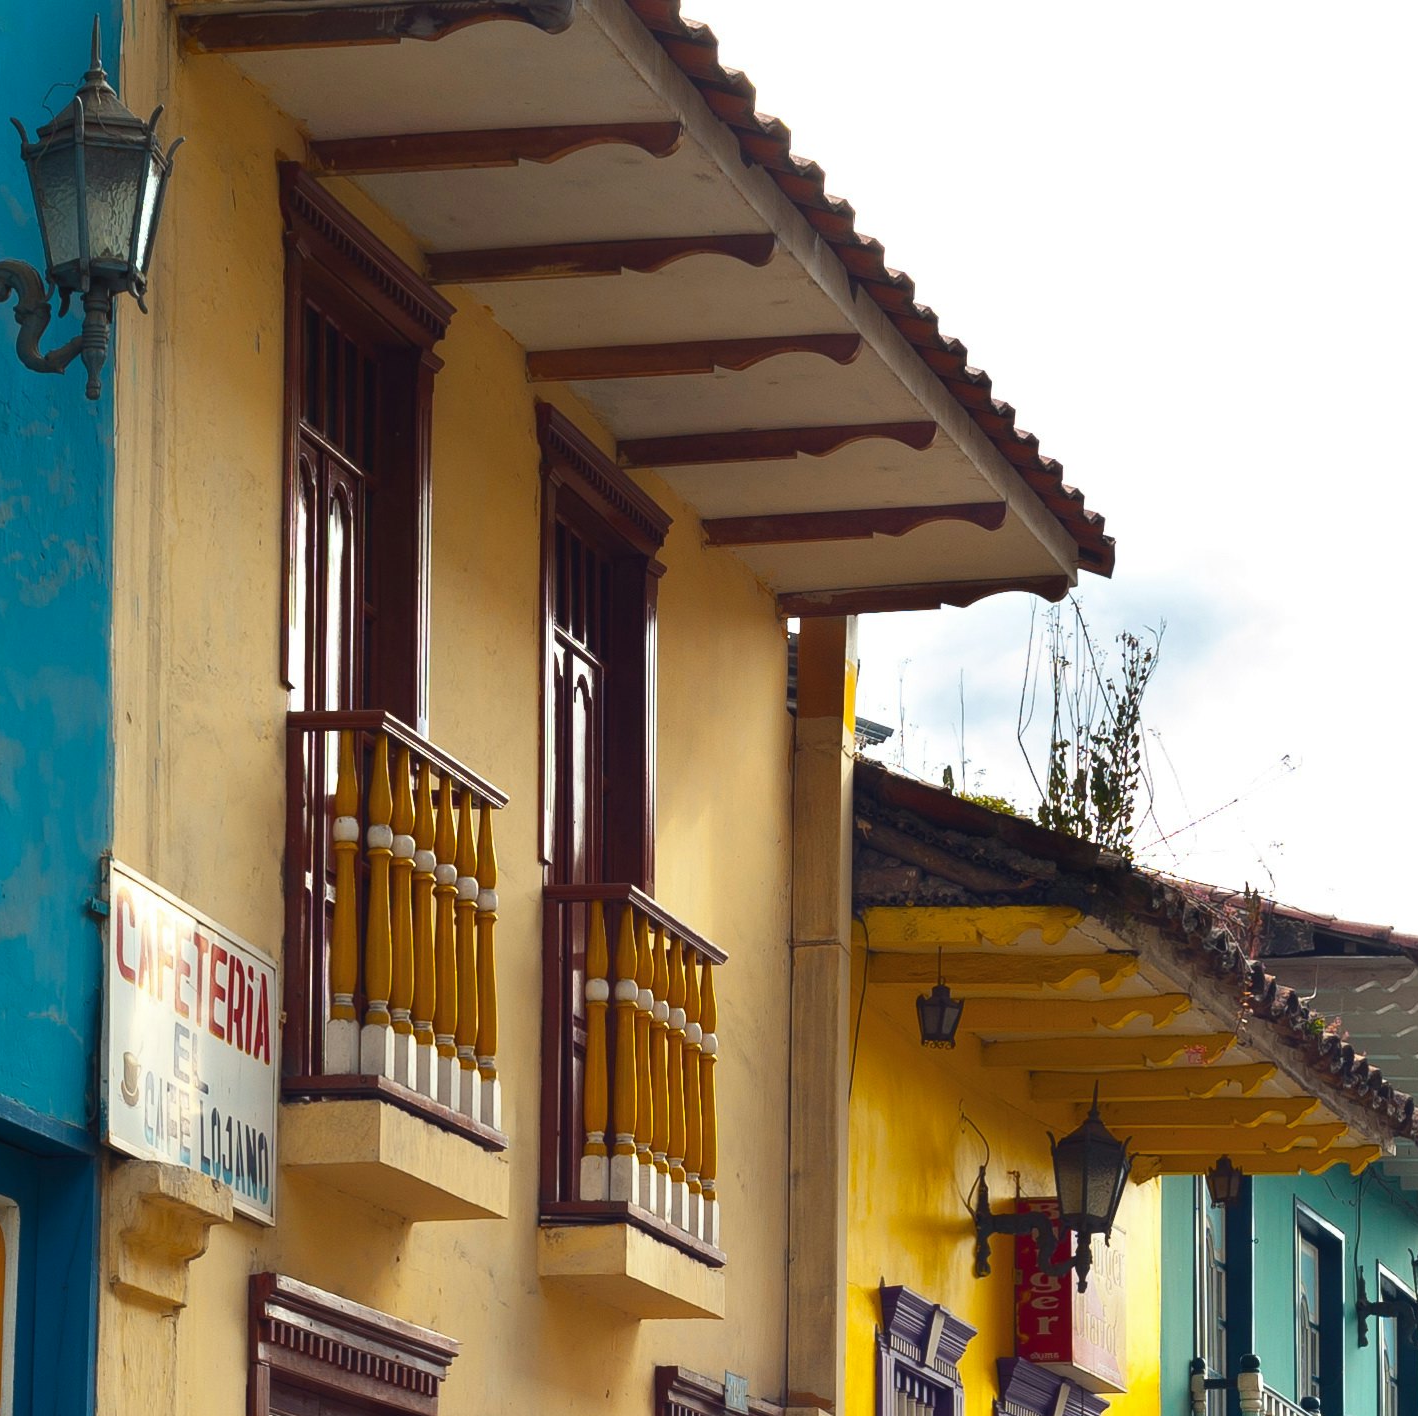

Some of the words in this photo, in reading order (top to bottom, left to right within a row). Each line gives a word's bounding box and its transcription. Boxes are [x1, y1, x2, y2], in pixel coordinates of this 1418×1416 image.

[173, 1021, 210, 1095] EL
[142, 1070, 192, 1167] CAFE
[199, 1104, 270, 1206] LOJANO
